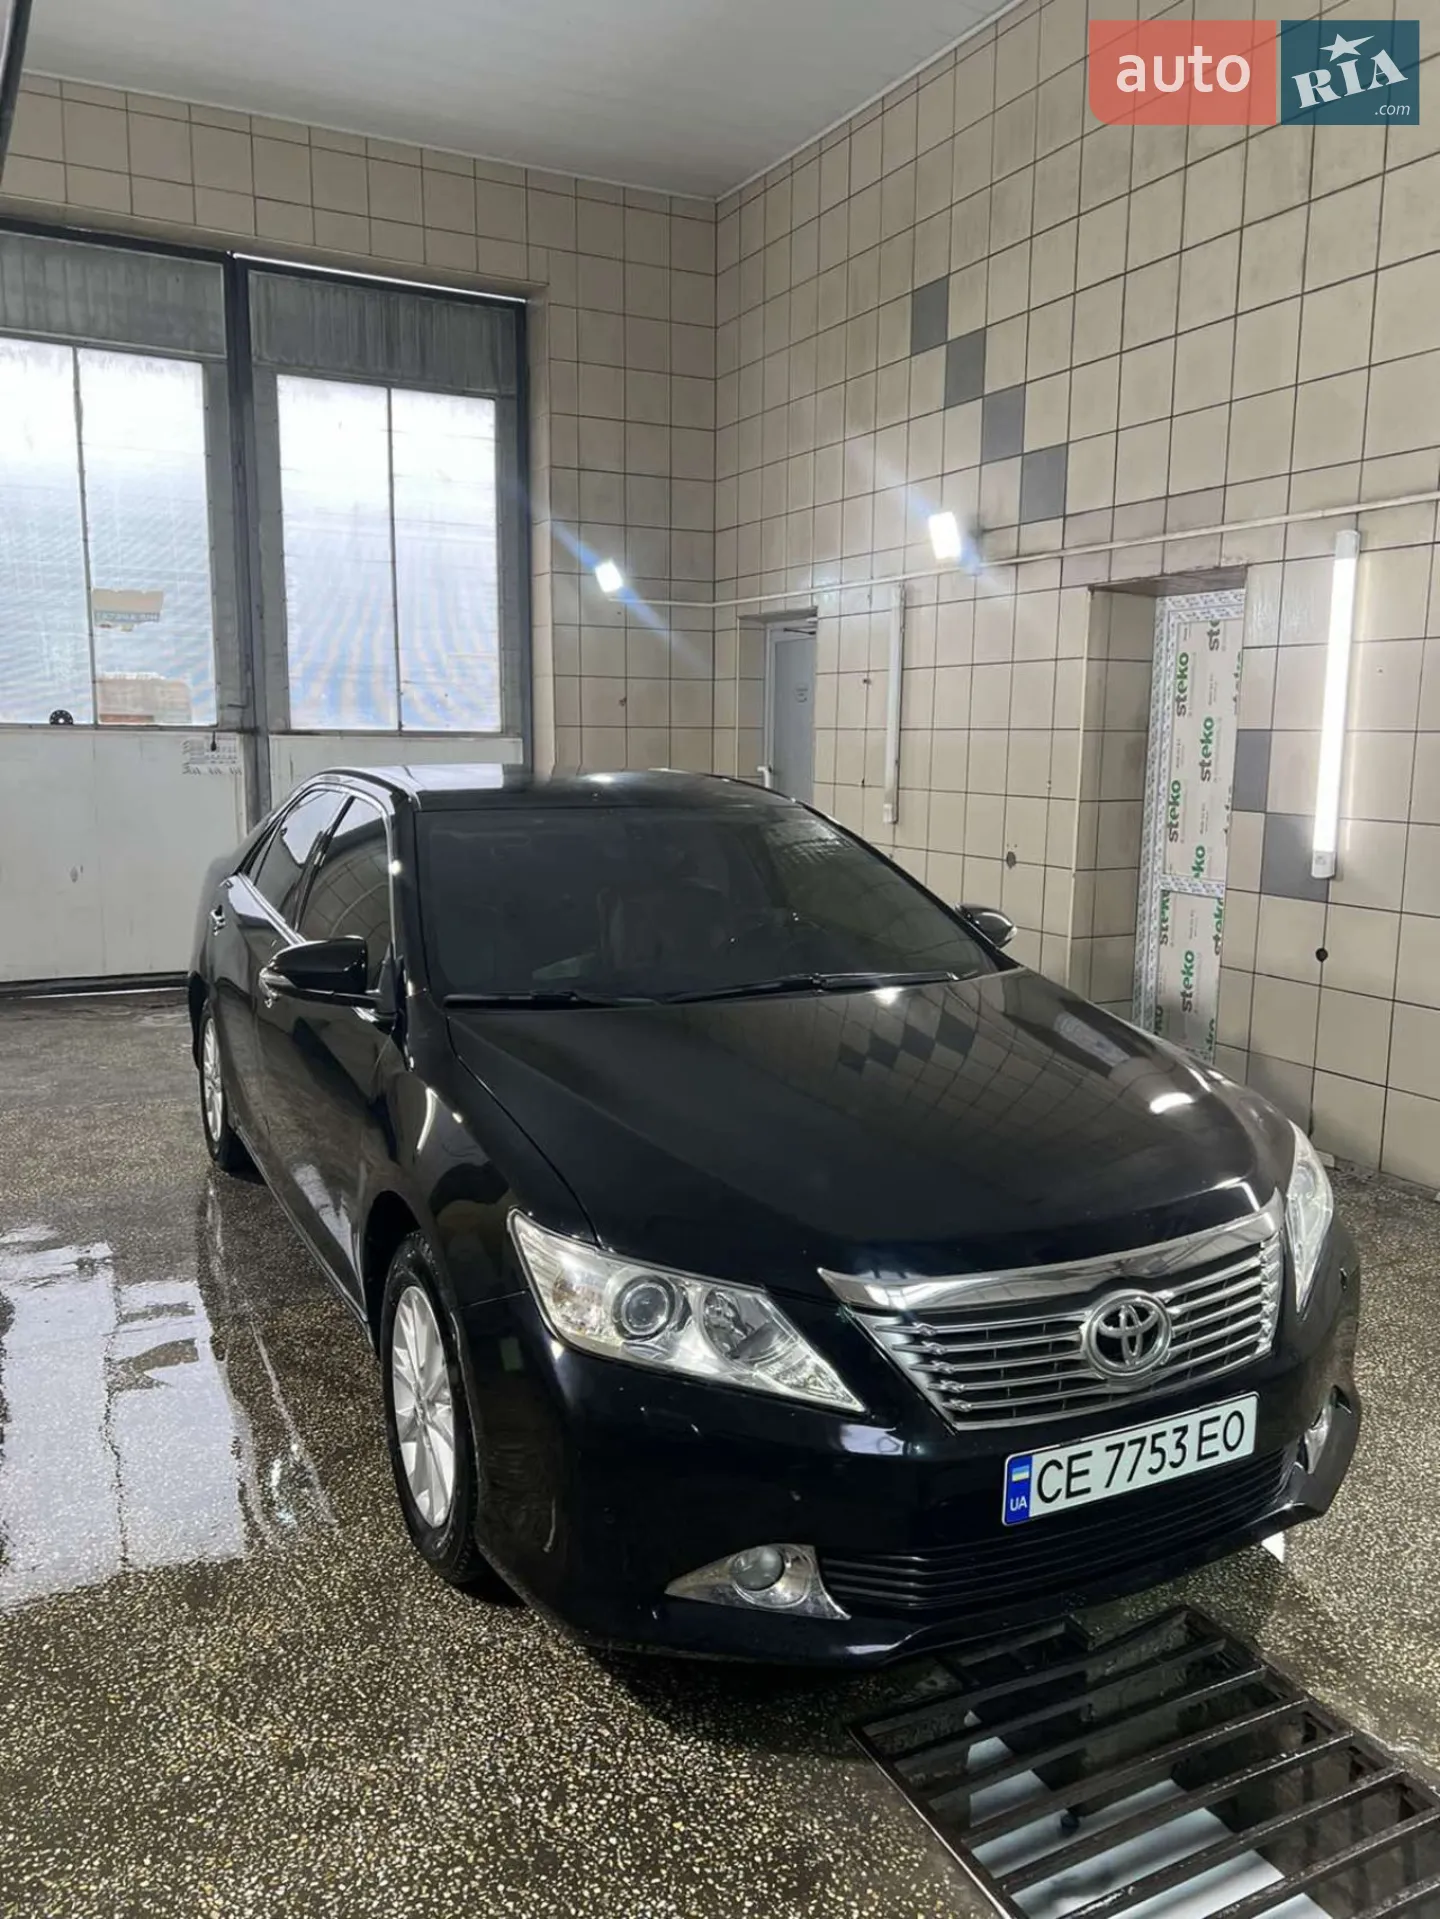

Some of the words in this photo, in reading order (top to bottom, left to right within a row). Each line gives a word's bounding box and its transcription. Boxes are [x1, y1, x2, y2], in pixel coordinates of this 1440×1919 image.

[1175, 651, 1190, 717] steko
[1199, 716, 1215, 782] steko
[1166, 779, 1182, 843] steko
[1191, 845, 1206, 879] ko
[1181, 950, 1196, 1014] steko
[1036, 1450, 1093, 1504] CE
[1104, 1425, 1189, 1489] 7753
[1197, 1410, 1245, 1462] EO
[1010, 1495, 1028, 1512] UA
